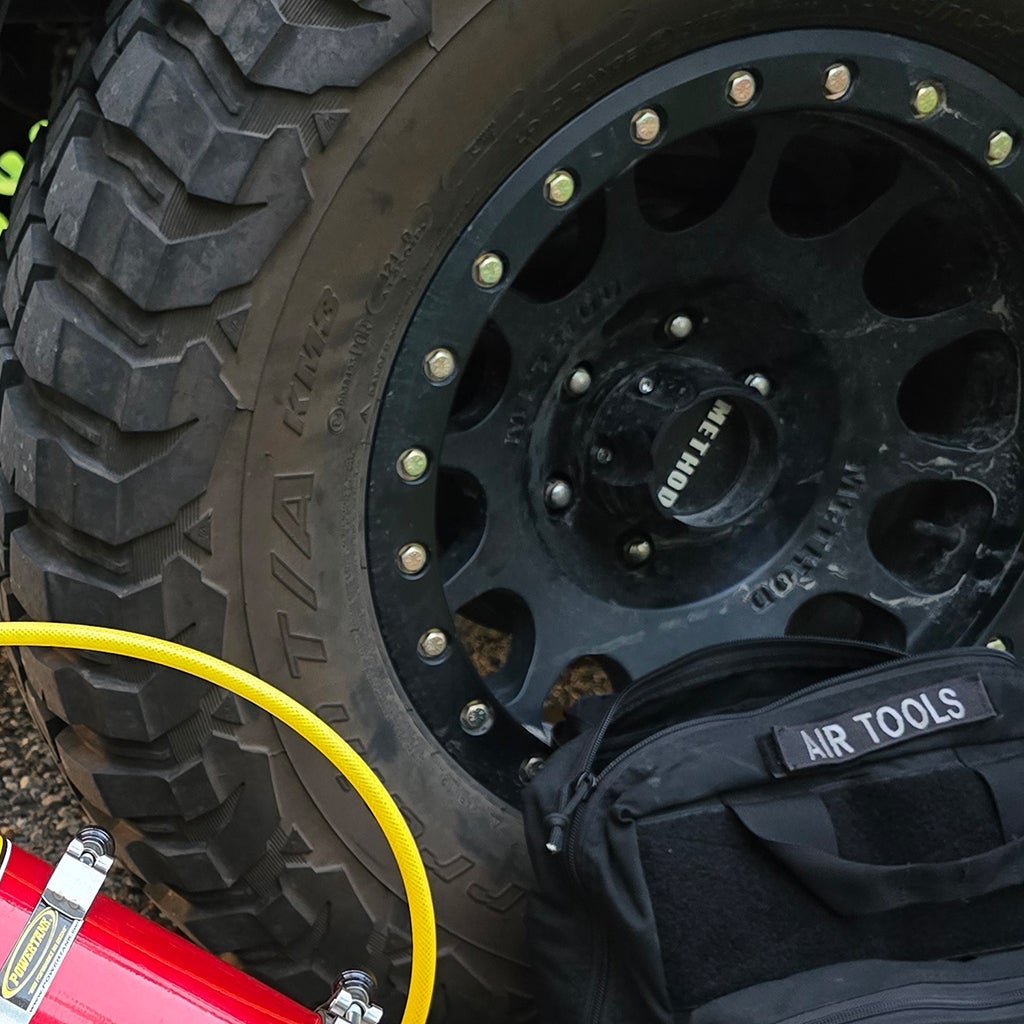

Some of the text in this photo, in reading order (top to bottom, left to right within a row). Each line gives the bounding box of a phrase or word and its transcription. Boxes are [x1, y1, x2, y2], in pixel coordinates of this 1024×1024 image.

[657, 397, 733, 510] METHOD
[799, 686, 967, 761] AIR TOOLS
